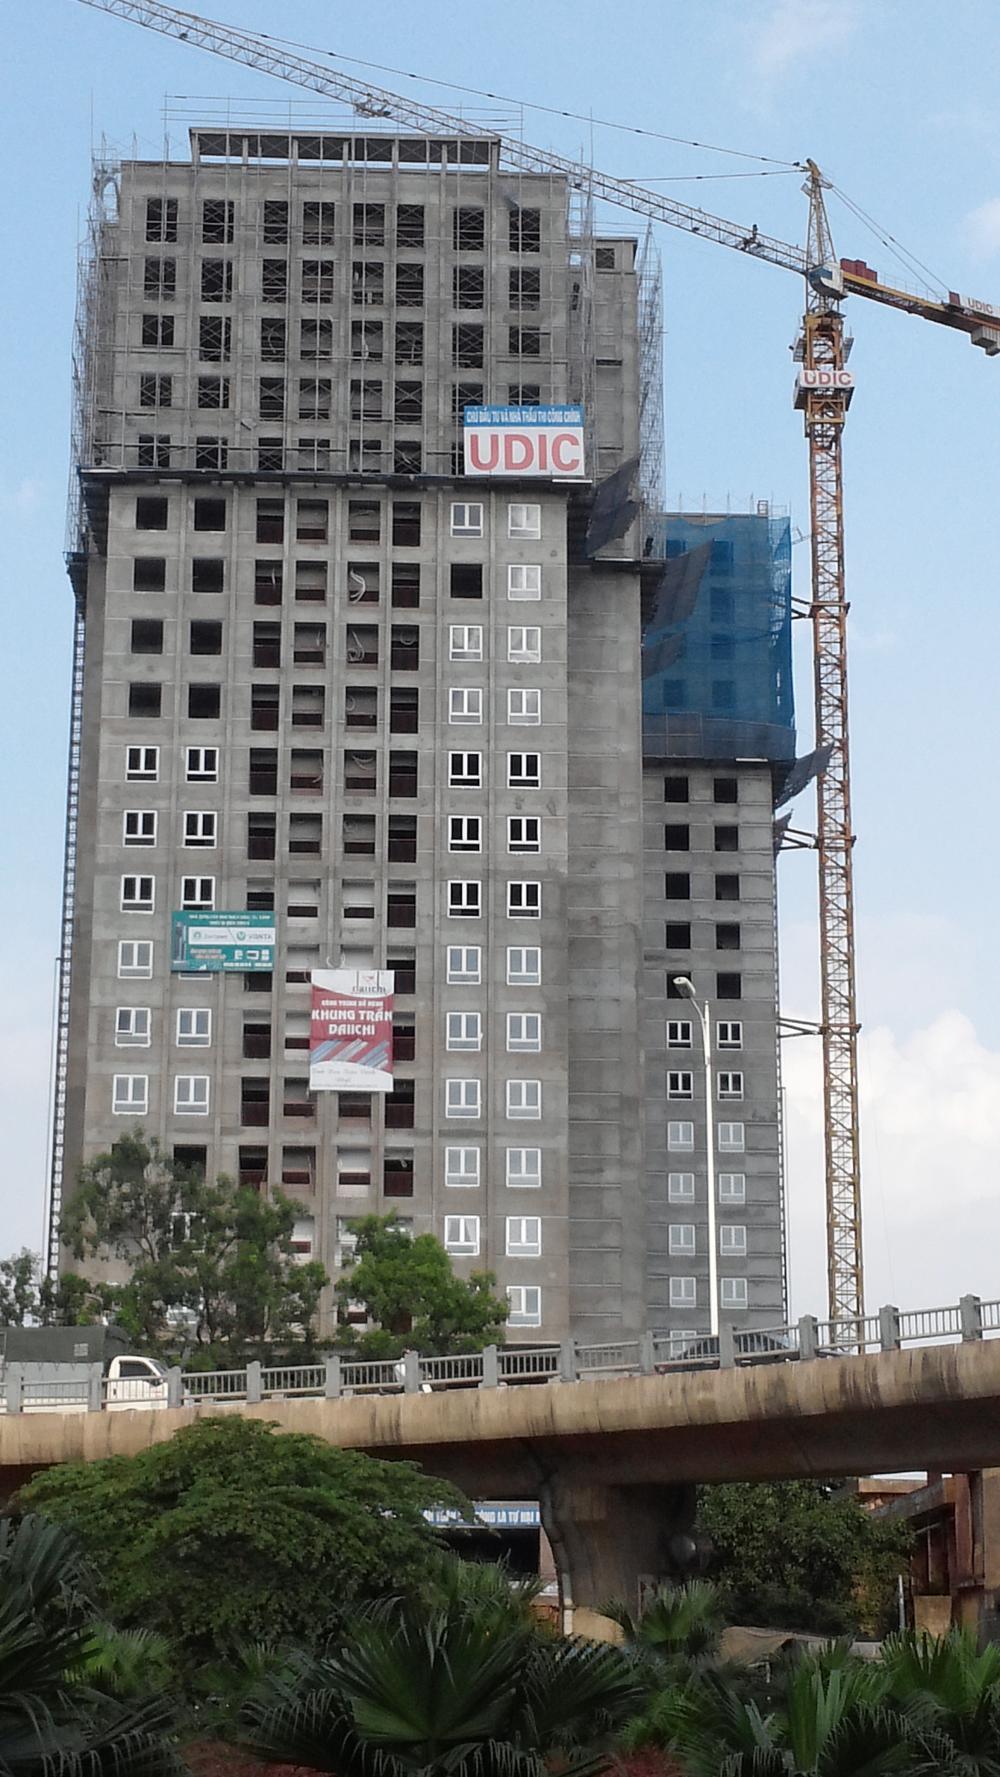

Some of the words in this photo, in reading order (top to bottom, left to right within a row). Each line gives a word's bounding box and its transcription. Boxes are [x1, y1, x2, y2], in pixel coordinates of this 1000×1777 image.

[968, 297, 993, 314] UDIC
[804, 371, 851, 386] UDIC
[470, 433, 580, 472] UDIC
[311, 1009, 356, 1020] KHUNG
[328, 1023, 376, 1036] DAIICHI
